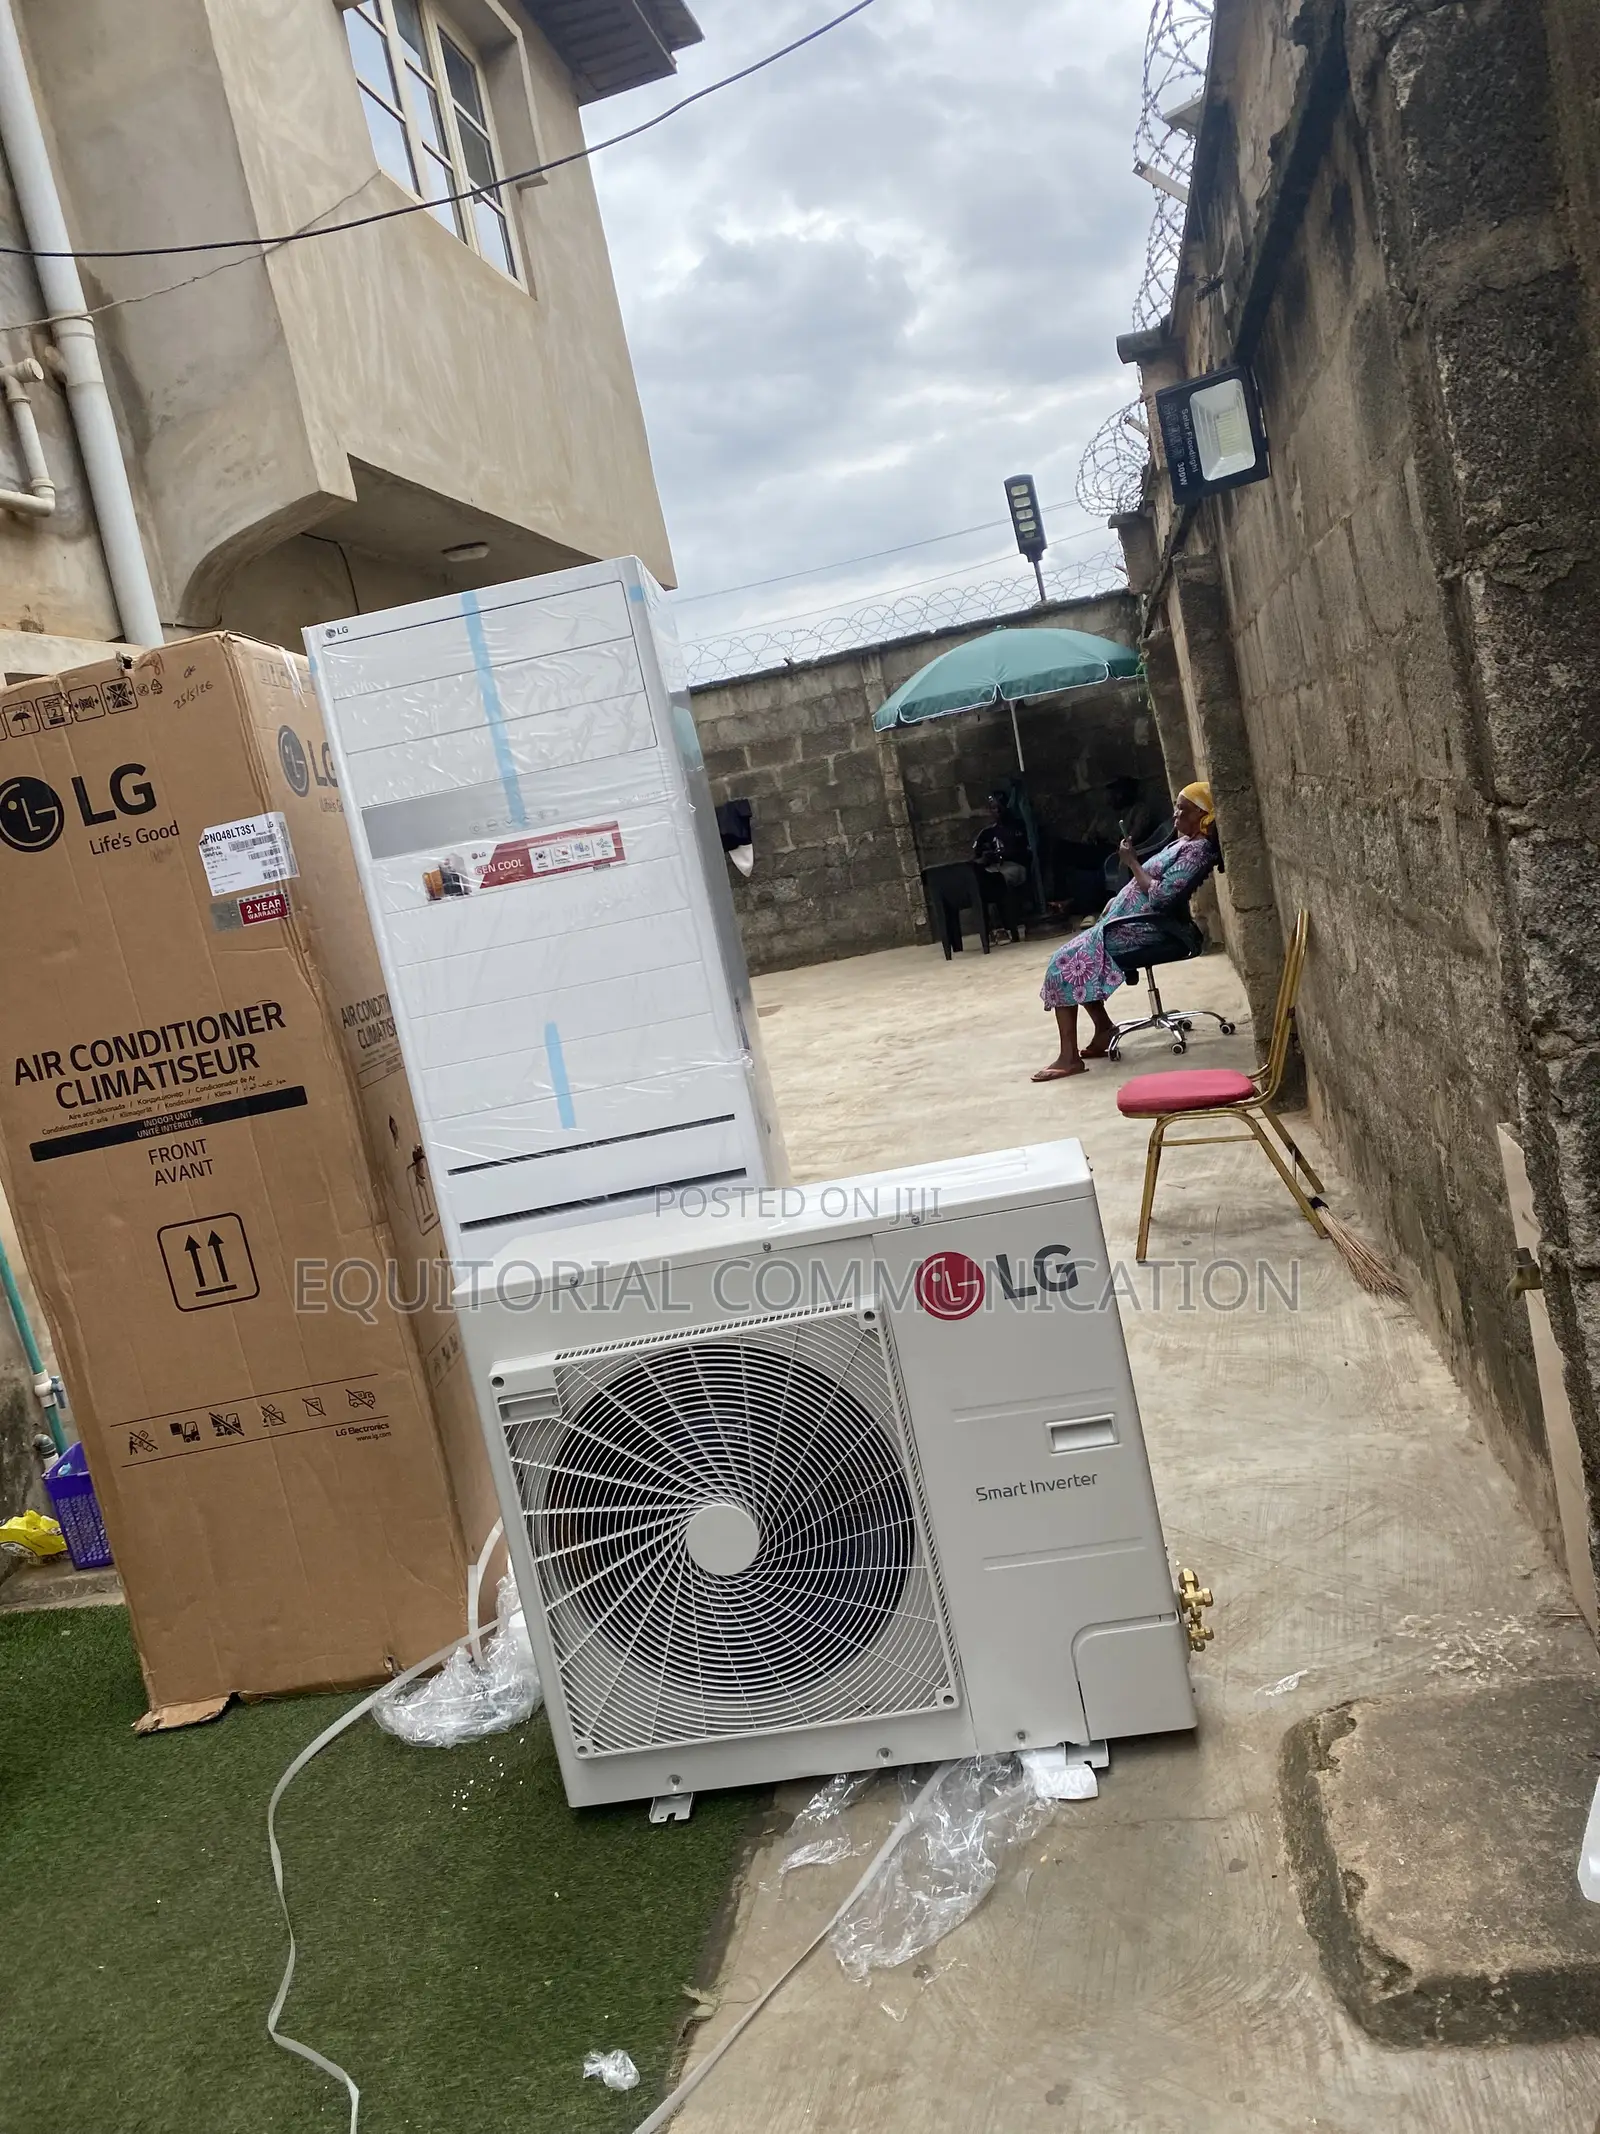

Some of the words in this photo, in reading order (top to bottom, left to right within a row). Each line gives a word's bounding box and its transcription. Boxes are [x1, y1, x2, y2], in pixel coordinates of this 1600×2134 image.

[1182, 408, 1190, 430] Solar
[1186, 431, 1199, 473] Floodlight
[1177, 461, 1188, 486] 300W
[336, 625, 349, 635] LG
[71, 763, 157, 827] LG
[89, 832, 132, 856] Life's
[135, 820, 180, 844] Good
[497, 859, 525, 871] COOL
[246, 905, 253, 914] 2
[254, 899, 282, 912] YEAR
[247, 908, 282, 920] WARRANTY
[341, 1008, 359, 1029] AIR
[15, 1051, 66, 1087] AIR
[69, 1002, 287, 1072] CONDITIONER
[55, 1043, 260, 1110] CLIMATISEUR
[195, 1079, 239, 1093] Condicionador
[214, 1089, 232, 1098] Klima
[136, 1126, 160, 1138] UNITÉ
[161, 1117, 204, 1134] INTÉRIEURE
[143, 1114, 174, 1127] INDOOR
[176, 1110, 193, 1120] UNIT
[148, 1138, 207, 1165] FRONT
[154, 1158, 214, 1187] AVANT
[995, 1244, 1079, 1300] LG
[335, 1428, 348, 1437] LG
[348, 1422, 390, 1435] Electronics
[975, 1481, 1028, 1502] Smart
[1029, 1473, 1098, 1494] Inverter
